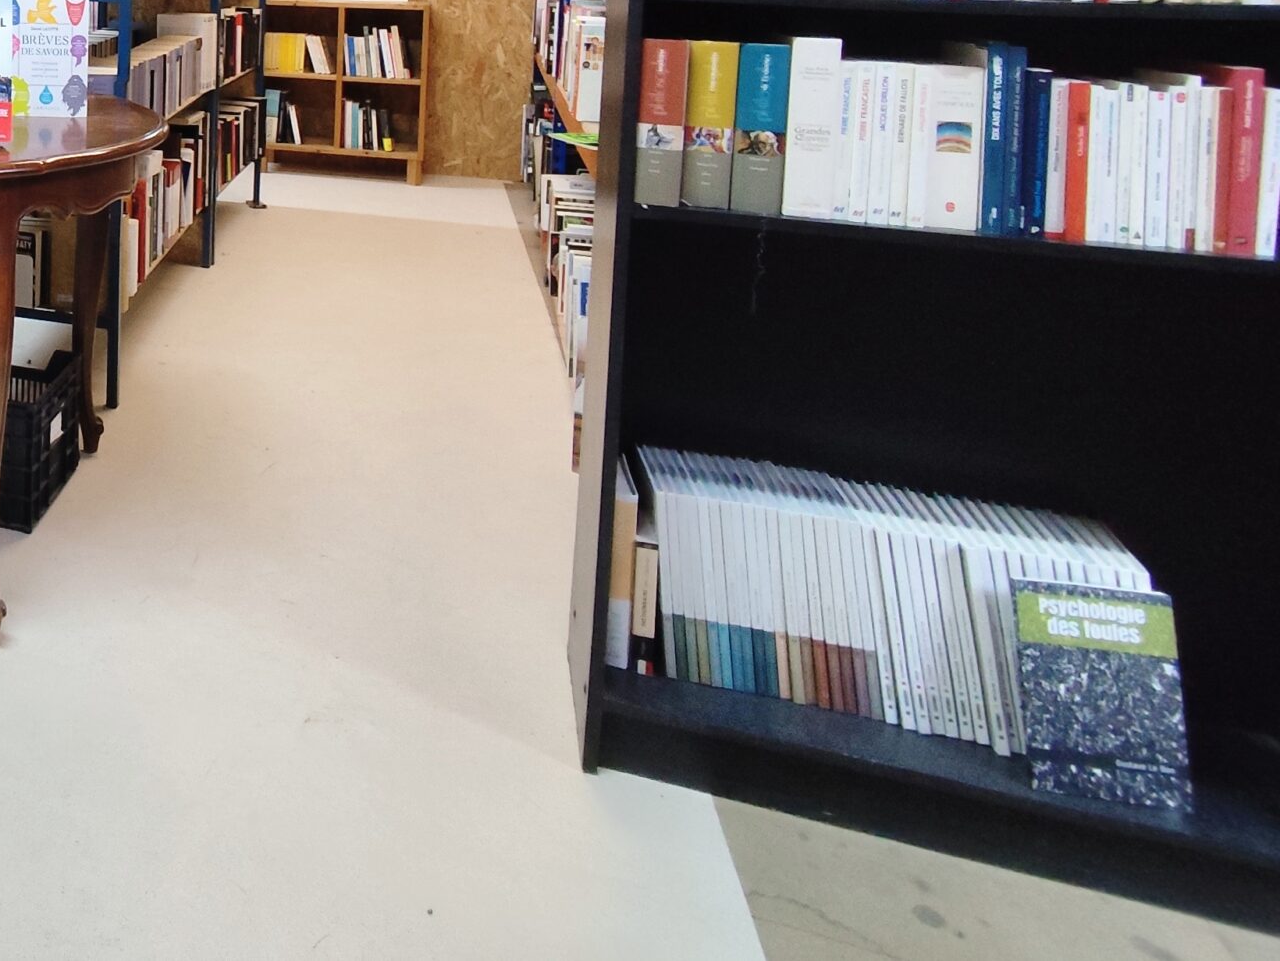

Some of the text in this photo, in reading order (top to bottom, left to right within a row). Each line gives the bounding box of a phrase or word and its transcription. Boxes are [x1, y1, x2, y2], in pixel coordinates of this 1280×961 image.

[22, 33, 69, 45] BRÈVES
[36, 48, 69, 56] SAVOIR
[993, 90, 1002, 109] AVEC
[897, 78, 908, 143] BERNARD DE FALLOIS
[992, 111, 1001, 125] ANS
[794, 126, 831, 136] Grandes
[1038, 597, 1146, 625] Psychologie
[1047, 617, 1080, 637] des
